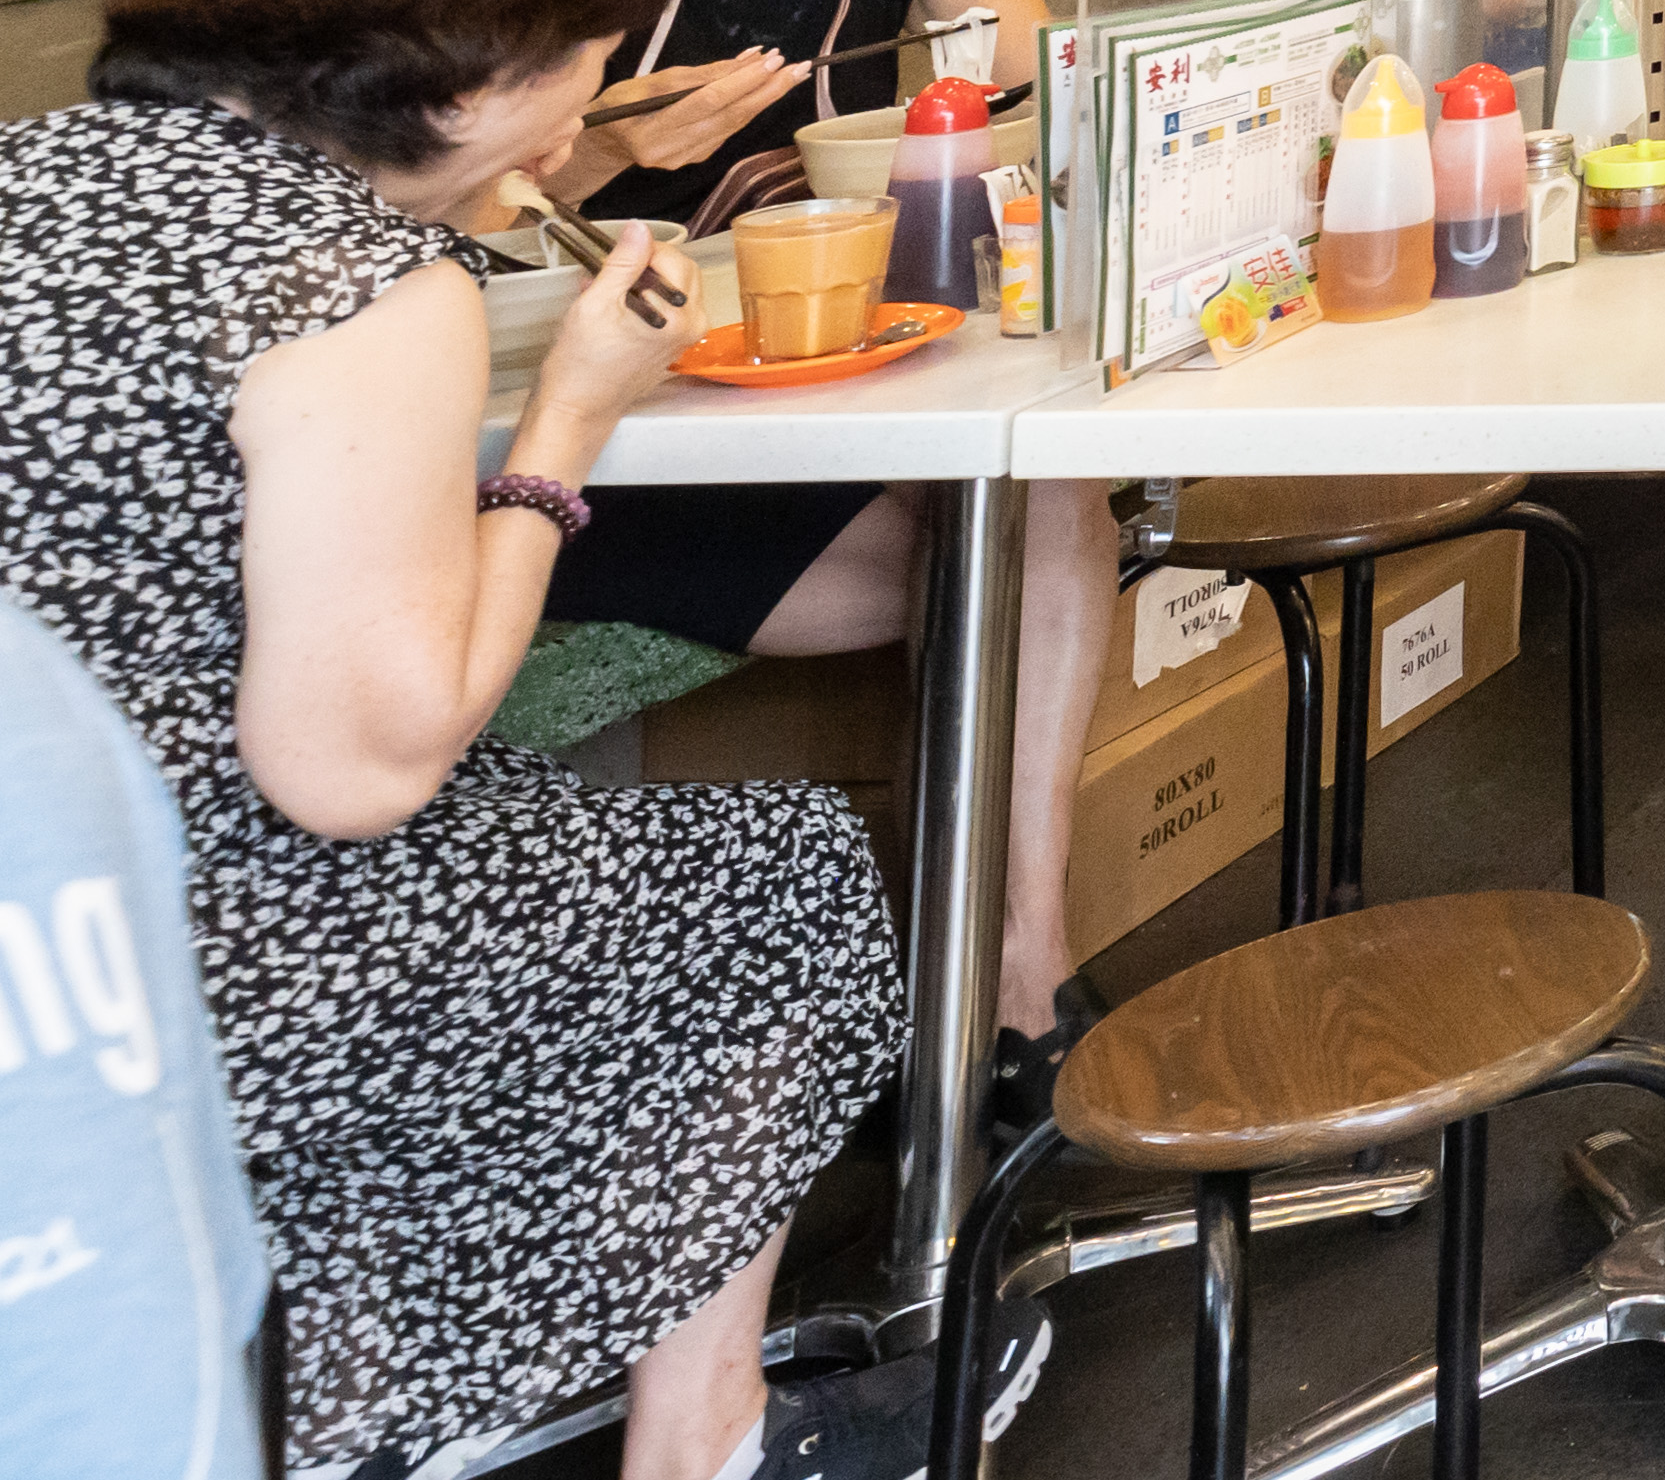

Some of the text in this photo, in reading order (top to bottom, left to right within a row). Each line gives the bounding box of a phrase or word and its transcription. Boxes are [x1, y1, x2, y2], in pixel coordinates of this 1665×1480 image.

[1145, 53, 1191, 93] 安利
[1243, 246, 1297, 293] 安佳
[1181, 602, 1233, 638] 7676A
[1402, 622, 1435, 653] 7676A
[1401, 639, 1450, 681] 50 ROLL
[1155, 756, 1216, 812] 80X80
[1139, 789, 1225, 860] 50ROLL
